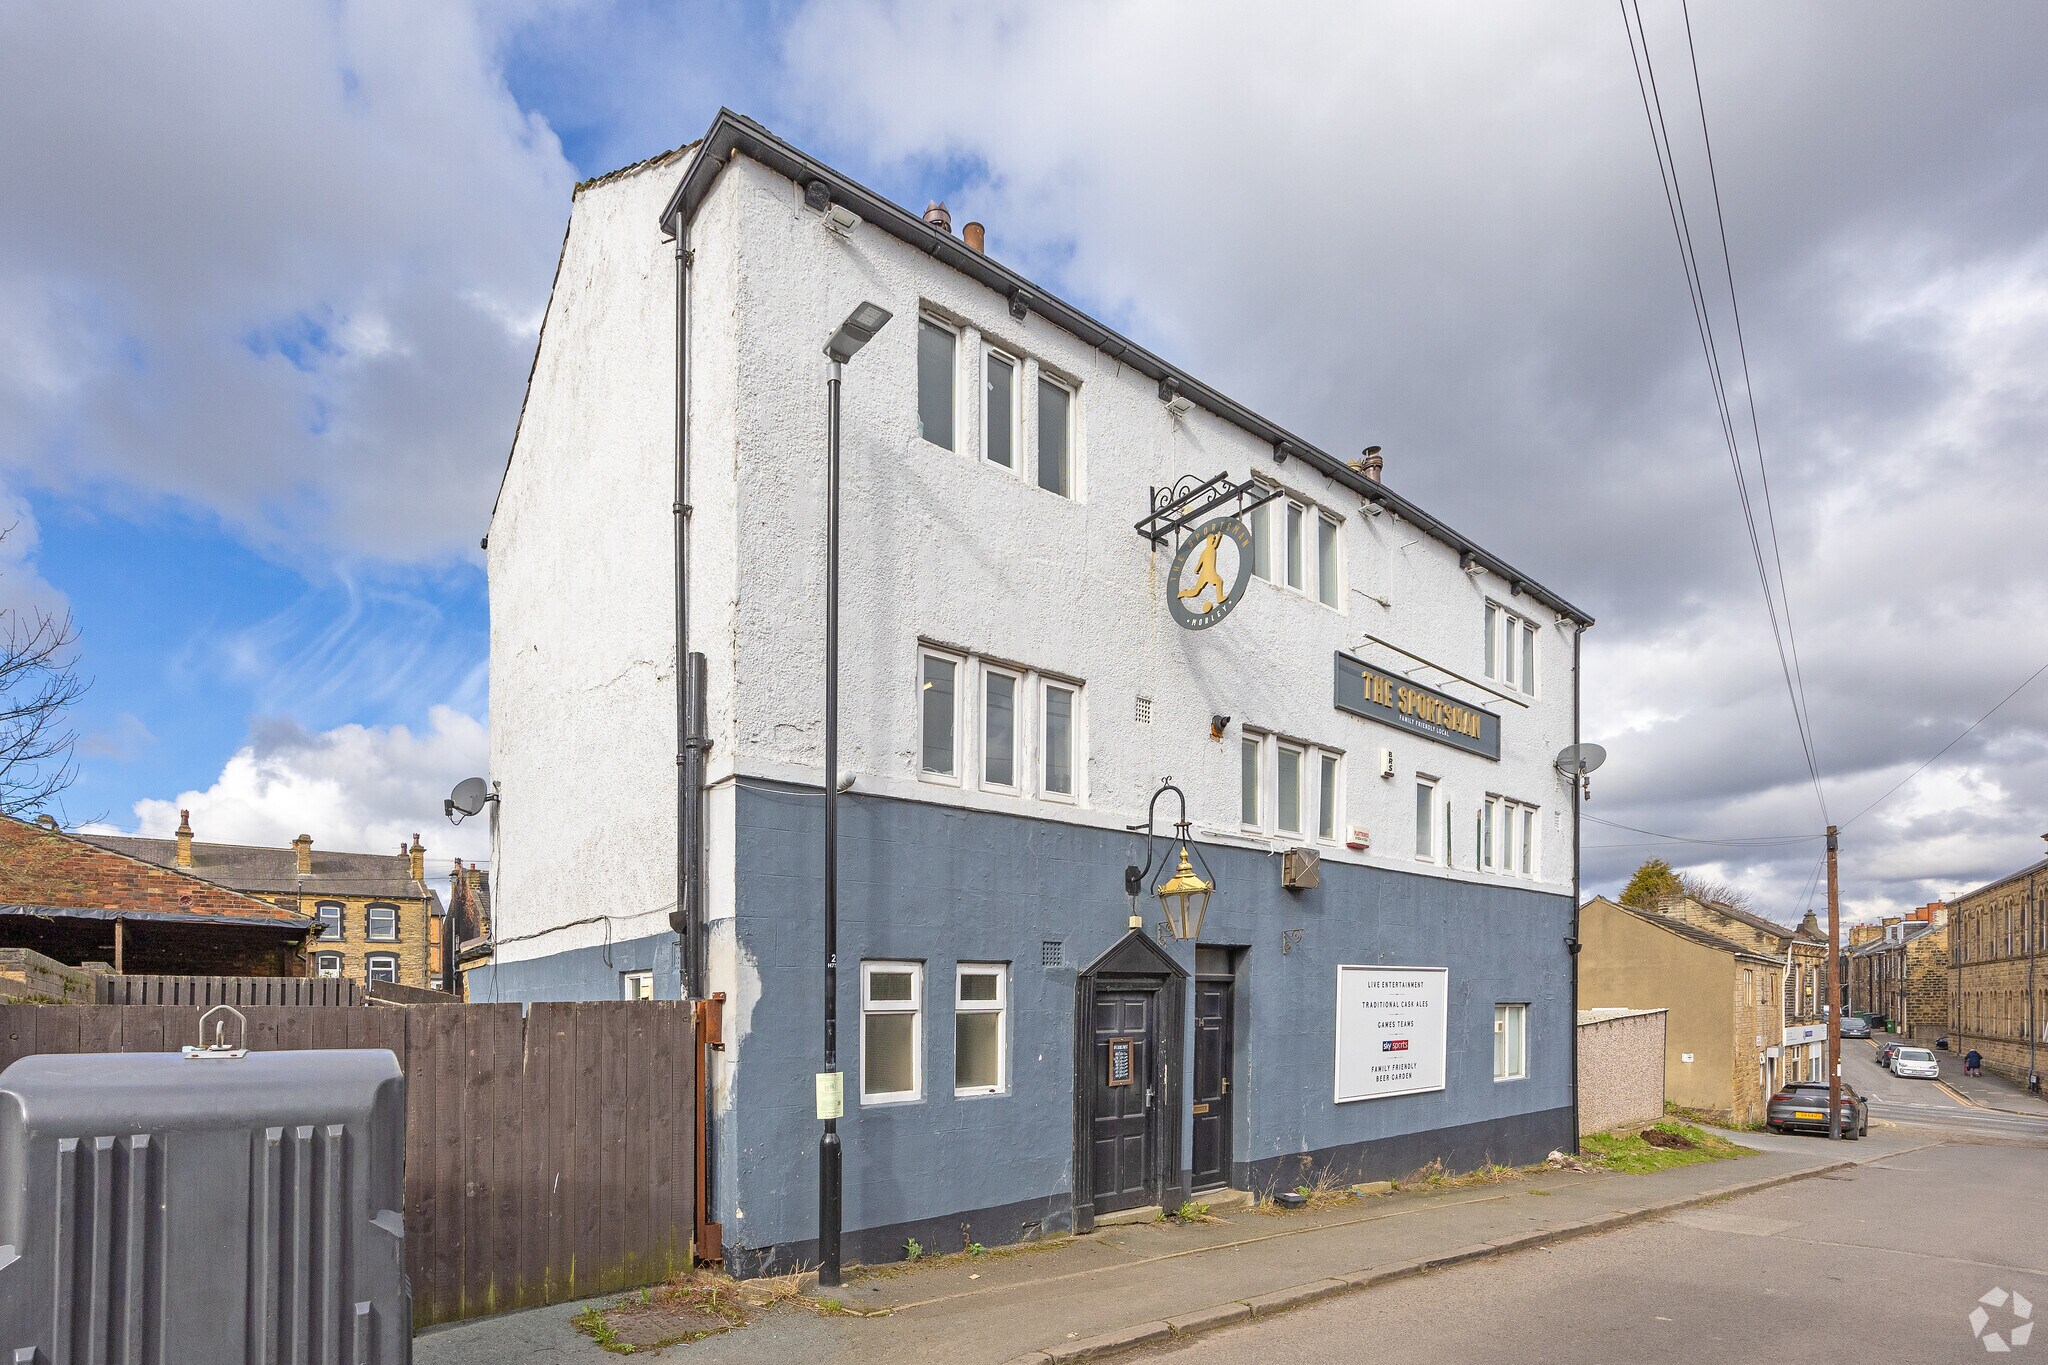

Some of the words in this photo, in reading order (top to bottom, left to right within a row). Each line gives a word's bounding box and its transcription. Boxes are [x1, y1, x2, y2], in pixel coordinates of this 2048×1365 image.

[1170, 556, 1184, 581] THE
[1188, 521, 1250, 549] SPORTSMAN
[1191, 605, 1228, 626] MORLEY
[1361, 671, 1393, 708] THE
[1398, 686, 1481, 739] SPORTSMAN
[1399, 714, 1414, 724] FAMILY
[1415, 720, 1435, 732] FRIENDLY
[1436, 727, 1449, 737] LOCAL
[831, 954, 836, 962] 2
[1397, 1020, 1414, 1028] TEAMS
[1383, 1041, 1392, 1051] sky
[1392, 1041, 1408, 1050] sports
[1371, 1064, 1391, 1073] FAMILY
[1392, 1062, 1417, 1071] FRIENDLY
[1376, 1074, 1390, 1082] BEER
[1391, 1072, 1412, 1081] GARDEN
